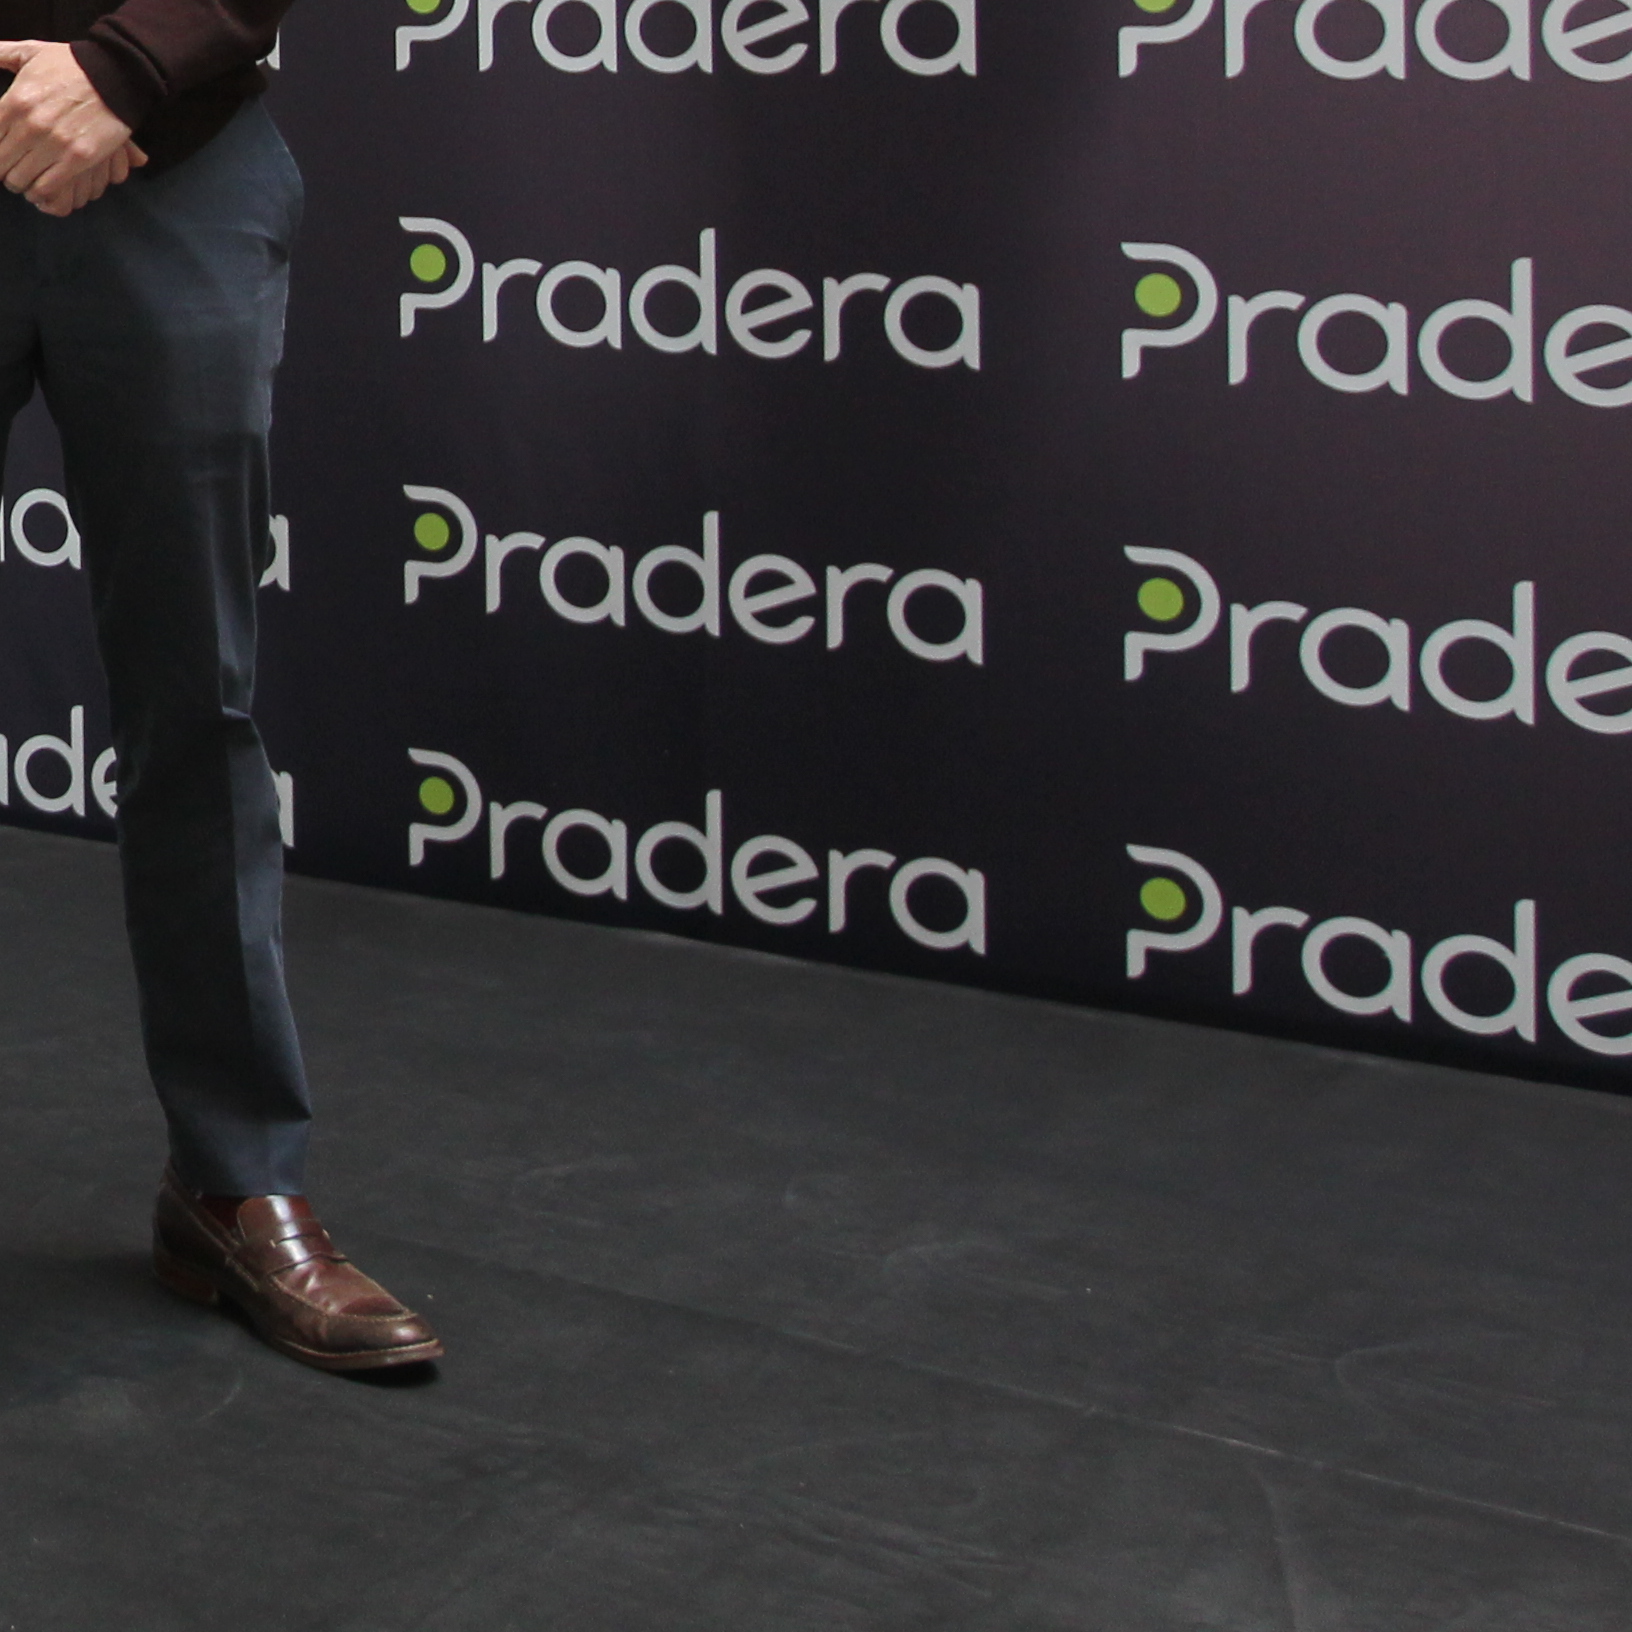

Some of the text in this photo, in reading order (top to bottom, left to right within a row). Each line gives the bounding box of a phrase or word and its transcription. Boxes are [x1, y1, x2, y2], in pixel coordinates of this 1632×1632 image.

[399, 217, 980, 370] Pradera
[1121, 243, 1632, 407] Prade
[403, 485, 983, 665] Pradera
[1124, 546, 1632, 734] Prade
[409, 748, 985, 954] Pradera
[1127, 844, 1632, 1055] Prade
